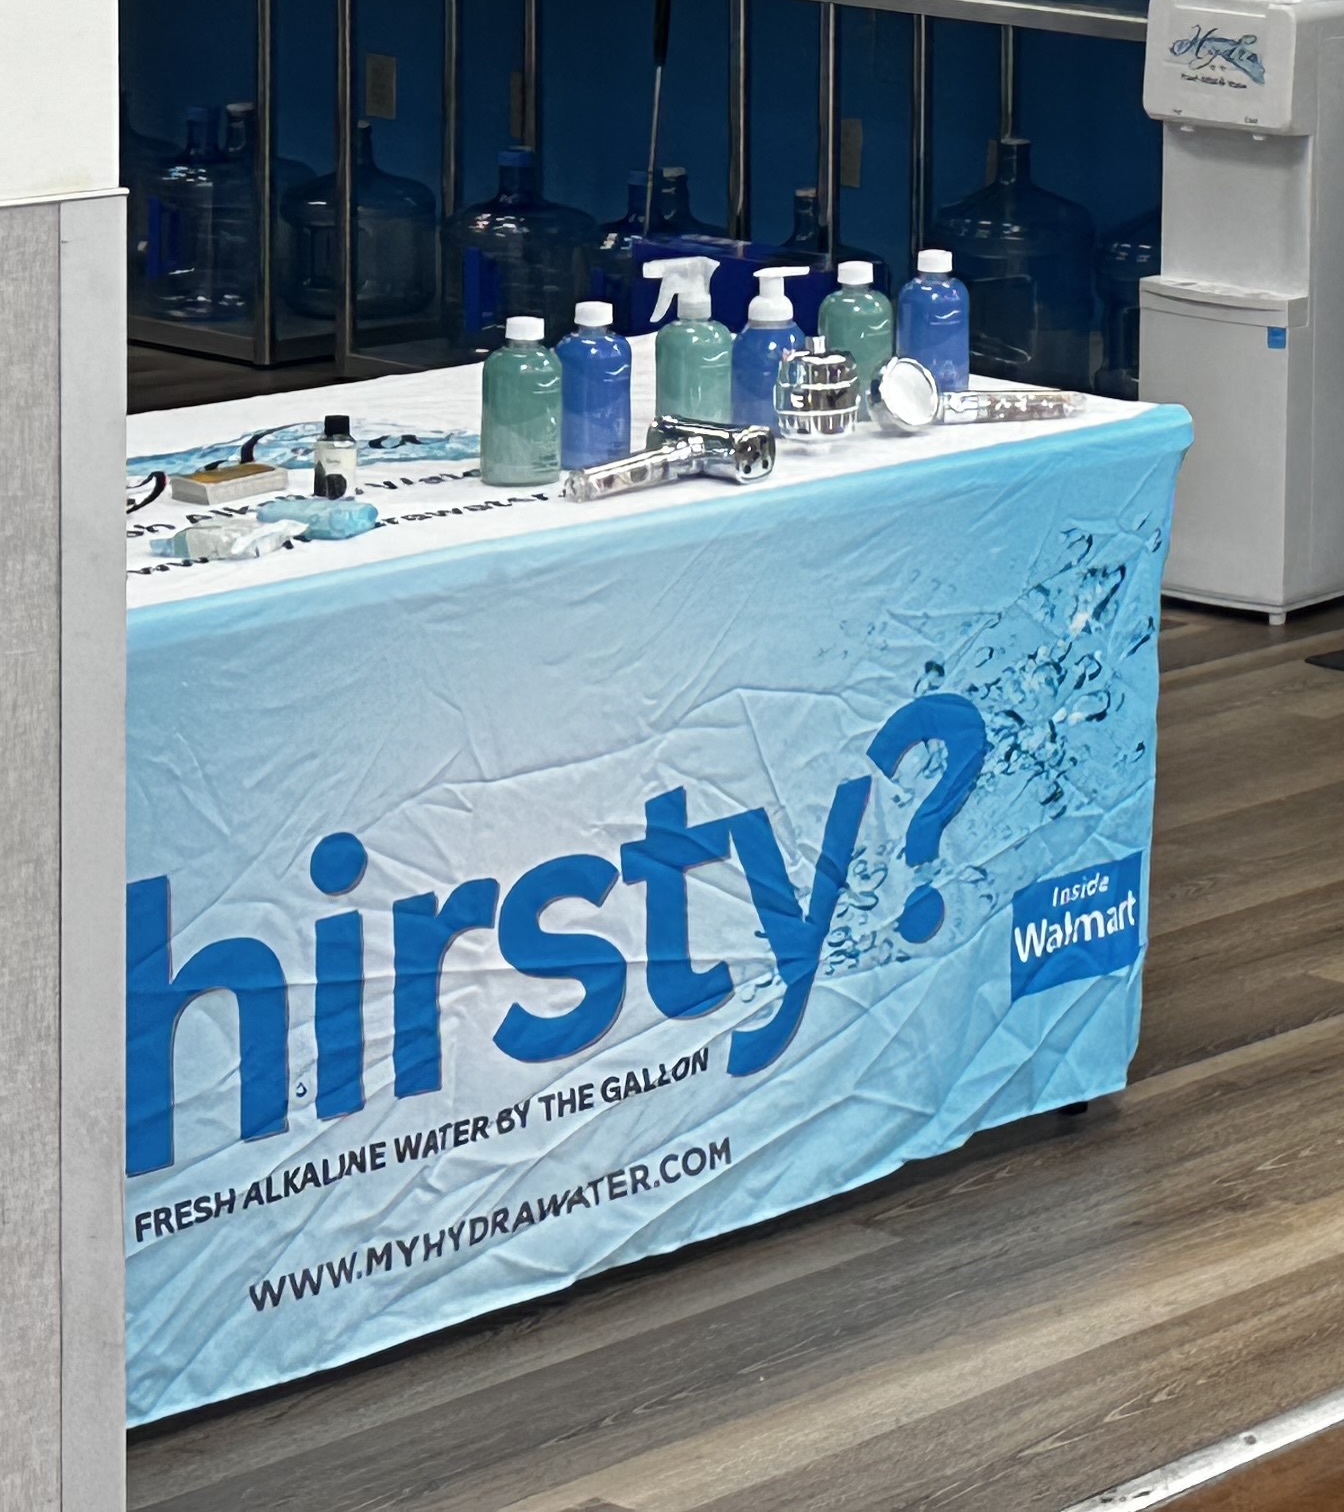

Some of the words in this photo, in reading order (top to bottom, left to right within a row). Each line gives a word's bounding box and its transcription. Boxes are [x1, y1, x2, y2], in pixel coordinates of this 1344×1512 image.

[1014, 889, 1137, 964] Walmart
[1052, 872, 1110, 907] Inside
[134, 1188, 237, 1243] FRESH
[242, 1141, 387, 1211] ALKALINE
[393, 1115, 490, 1164] WATER
[496, 1095, 531, 1135] BY
[537, 1083, 595, 1122] THE
[600, 1046, 709, 1104] GALLON
[248, 1136, 732, 1313] WWW.MYHYDRAWATER.COM
